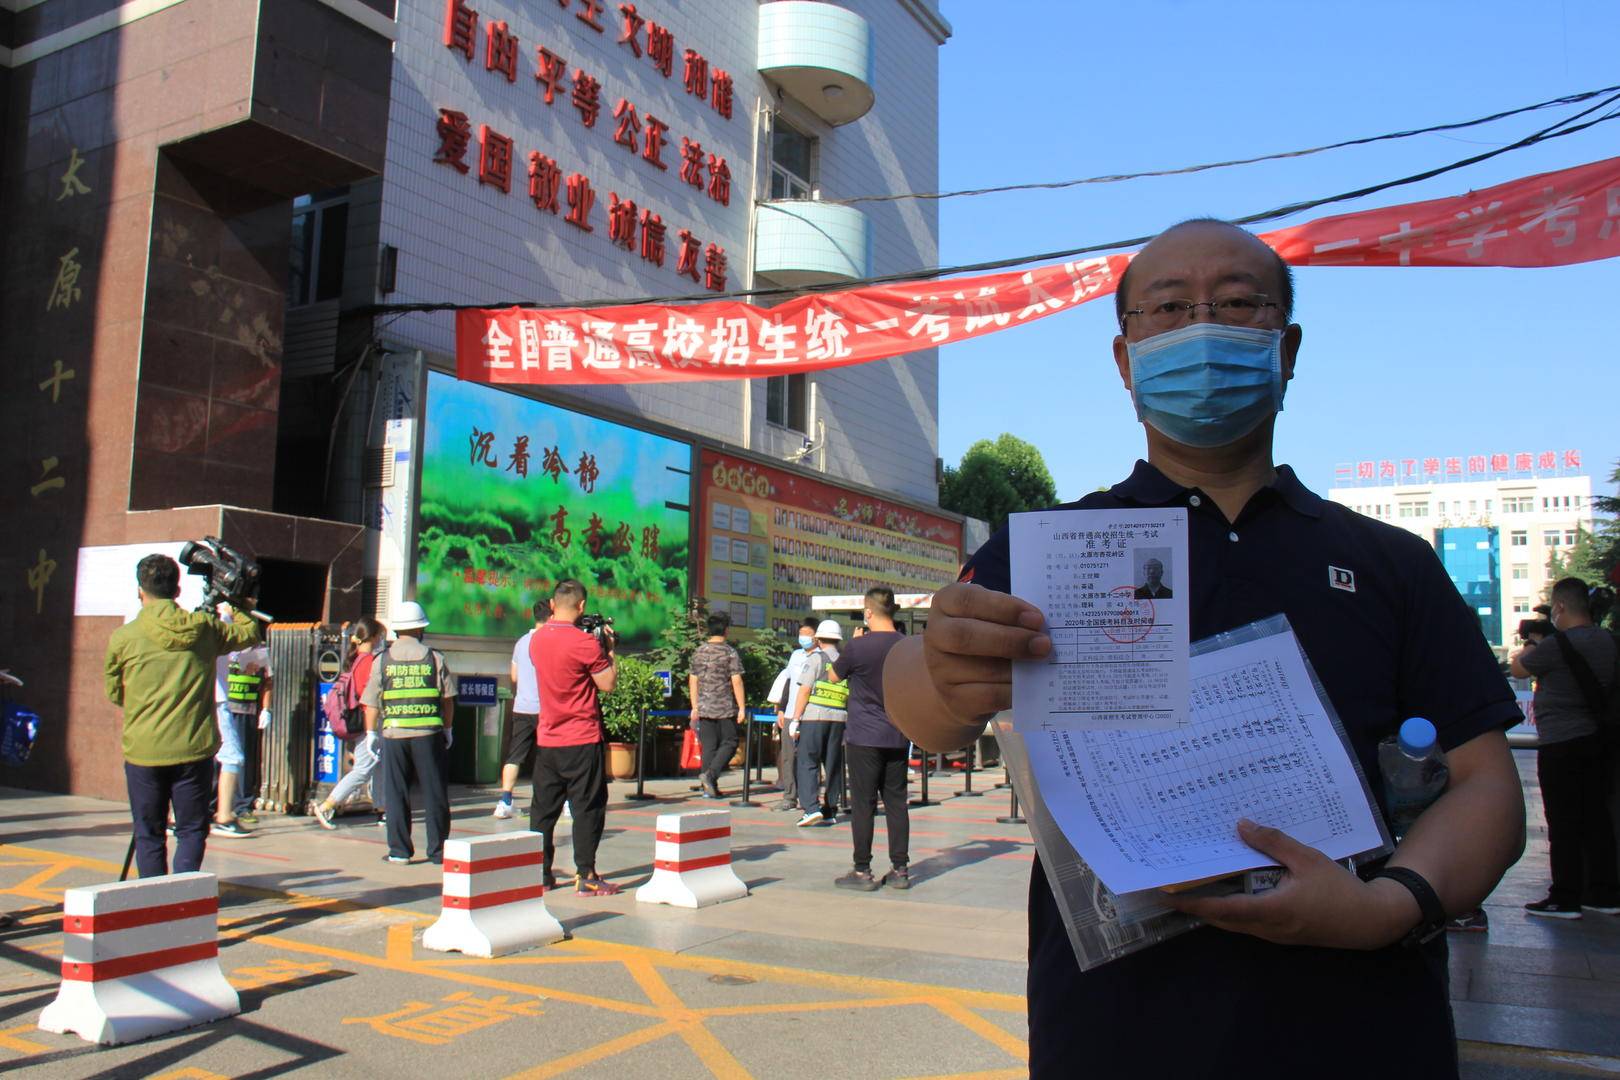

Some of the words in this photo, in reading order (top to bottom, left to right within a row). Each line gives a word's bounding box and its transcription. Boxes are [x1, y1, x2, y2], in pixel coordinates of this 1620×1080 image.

[618, 2, 674, 79] 文明
[684, 47, 733, 120] 和谐
[444, 0, 518, 84] 自由
[535, 45, 602, 129] 平等
[614, 98, 669, 172] 公正
[680, 136, 731, 207] 法治
[433, 107, 514, 194] 爱国
[528, 150, 596, 233] 敬业
[608, 191, 666, 268] 诚信
[676, 228, 727, 292] 友善
[482, 252, 1139, 372] 全国普通高校招生统一考试太原
[26, 147, 92, 615] 太原十二中
[469, 426, 600, 494] 沉着冷静
[1336, 450, 1582, 480] 一切为了学生的健康成长
[549, 505, 661, 561] 高考必胜
[1053, 530, 1159, 541] 山西省普通高校招生统一考试
[1086, 539, 1127, 549] 准考证
[385, 664, 432, 676] 消防疏散
[392, 676, 426, 688] 志愿队
